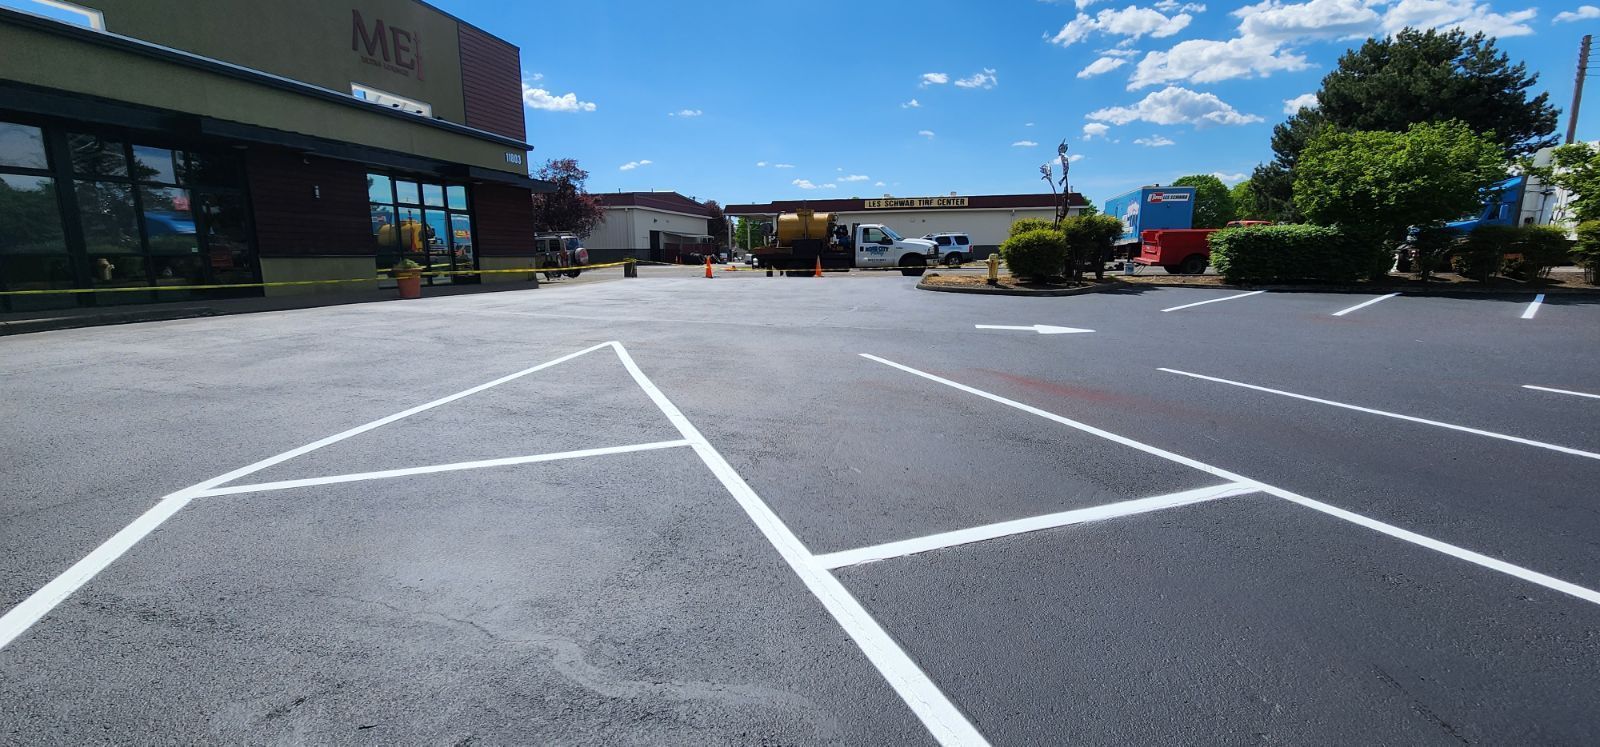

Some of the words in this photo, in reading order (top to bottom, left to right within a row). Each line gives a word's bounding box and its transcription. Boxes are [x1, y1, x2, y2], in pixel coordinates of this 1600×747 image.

[506, 152, 521, 164] 11803
[918, 198, 933, 206] TIRE
[937, 197, 965, 206] CENTER
